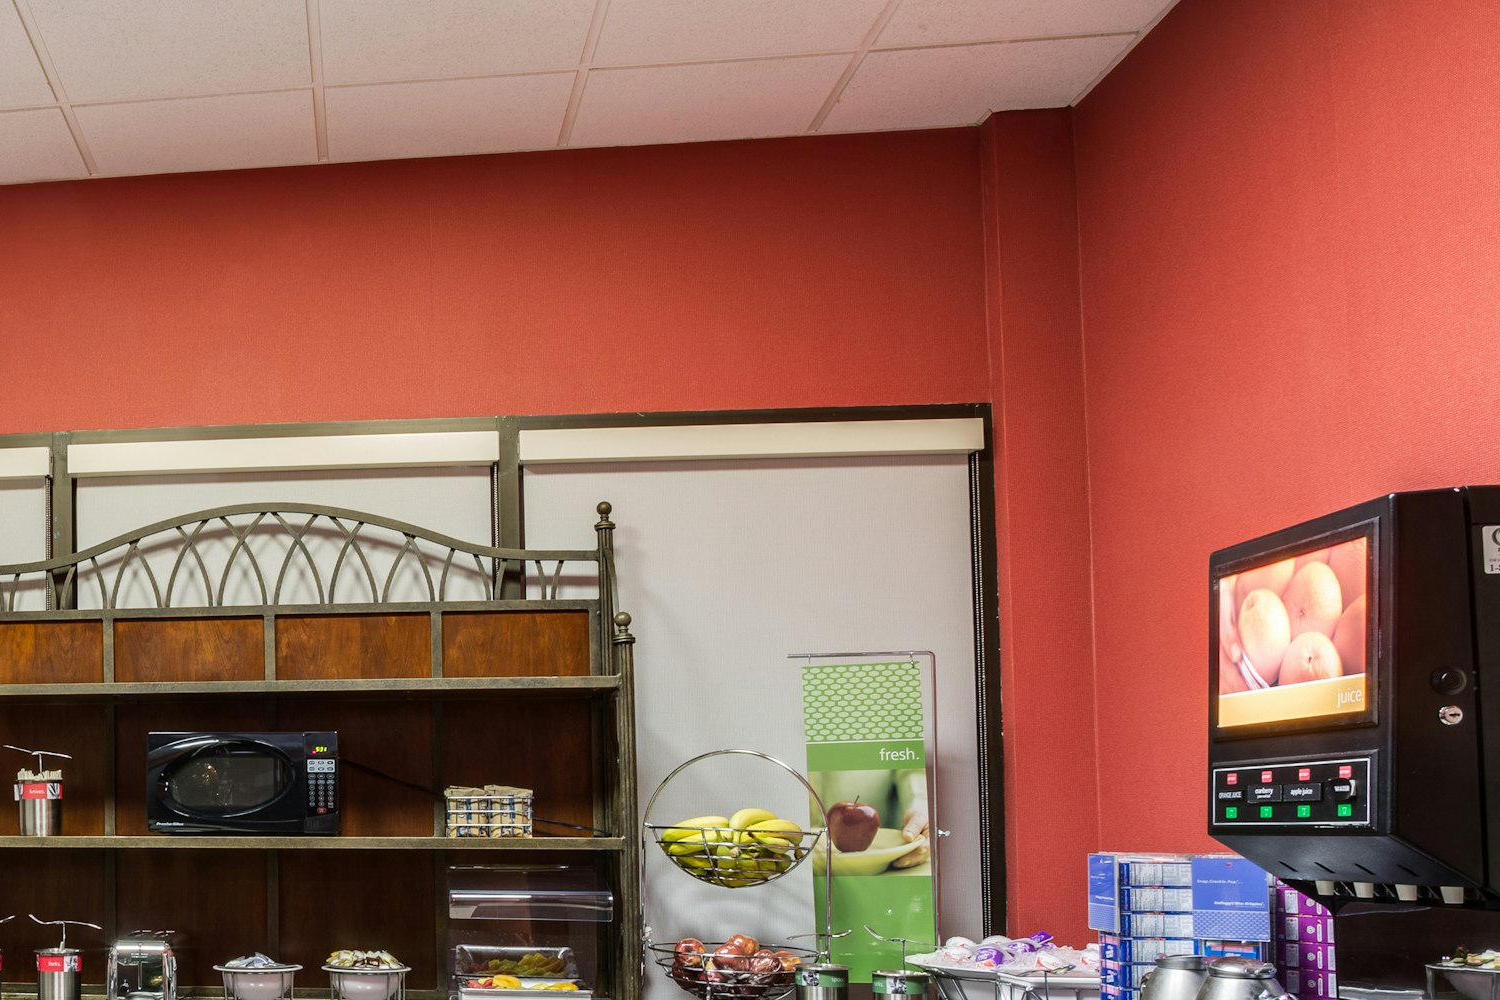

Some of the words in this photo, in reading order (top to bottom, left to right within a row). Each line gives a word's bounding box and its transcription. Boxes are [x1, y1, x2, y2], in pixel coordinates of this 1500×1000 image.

[1336, 687, 1365, 709] juice.
[878, 747, 920, 761] fresh.
[1254, 787, 1274, 795] cranberry
[1290, 788, 1302, 797] apple
[1302, 787, 1313, 796] juice
